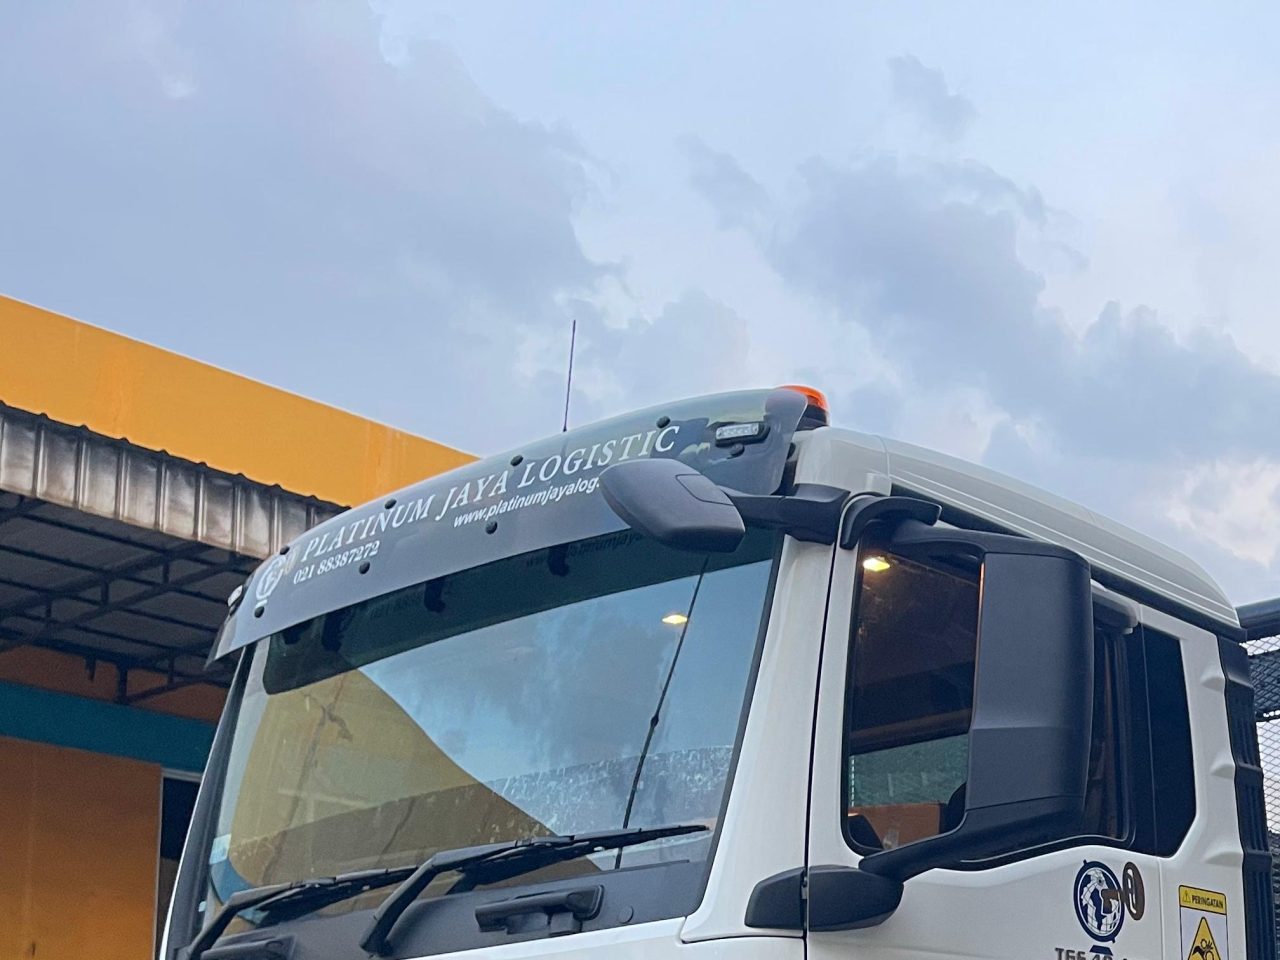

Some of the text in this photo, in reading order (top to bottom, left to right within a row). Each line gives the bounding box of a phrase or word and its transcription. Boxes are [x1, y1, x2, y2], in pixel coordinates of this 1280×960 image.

[301, 426, 680, 563] PLATINUM JAYA LOGISTIC
[294, 564, 315, 585] 021
